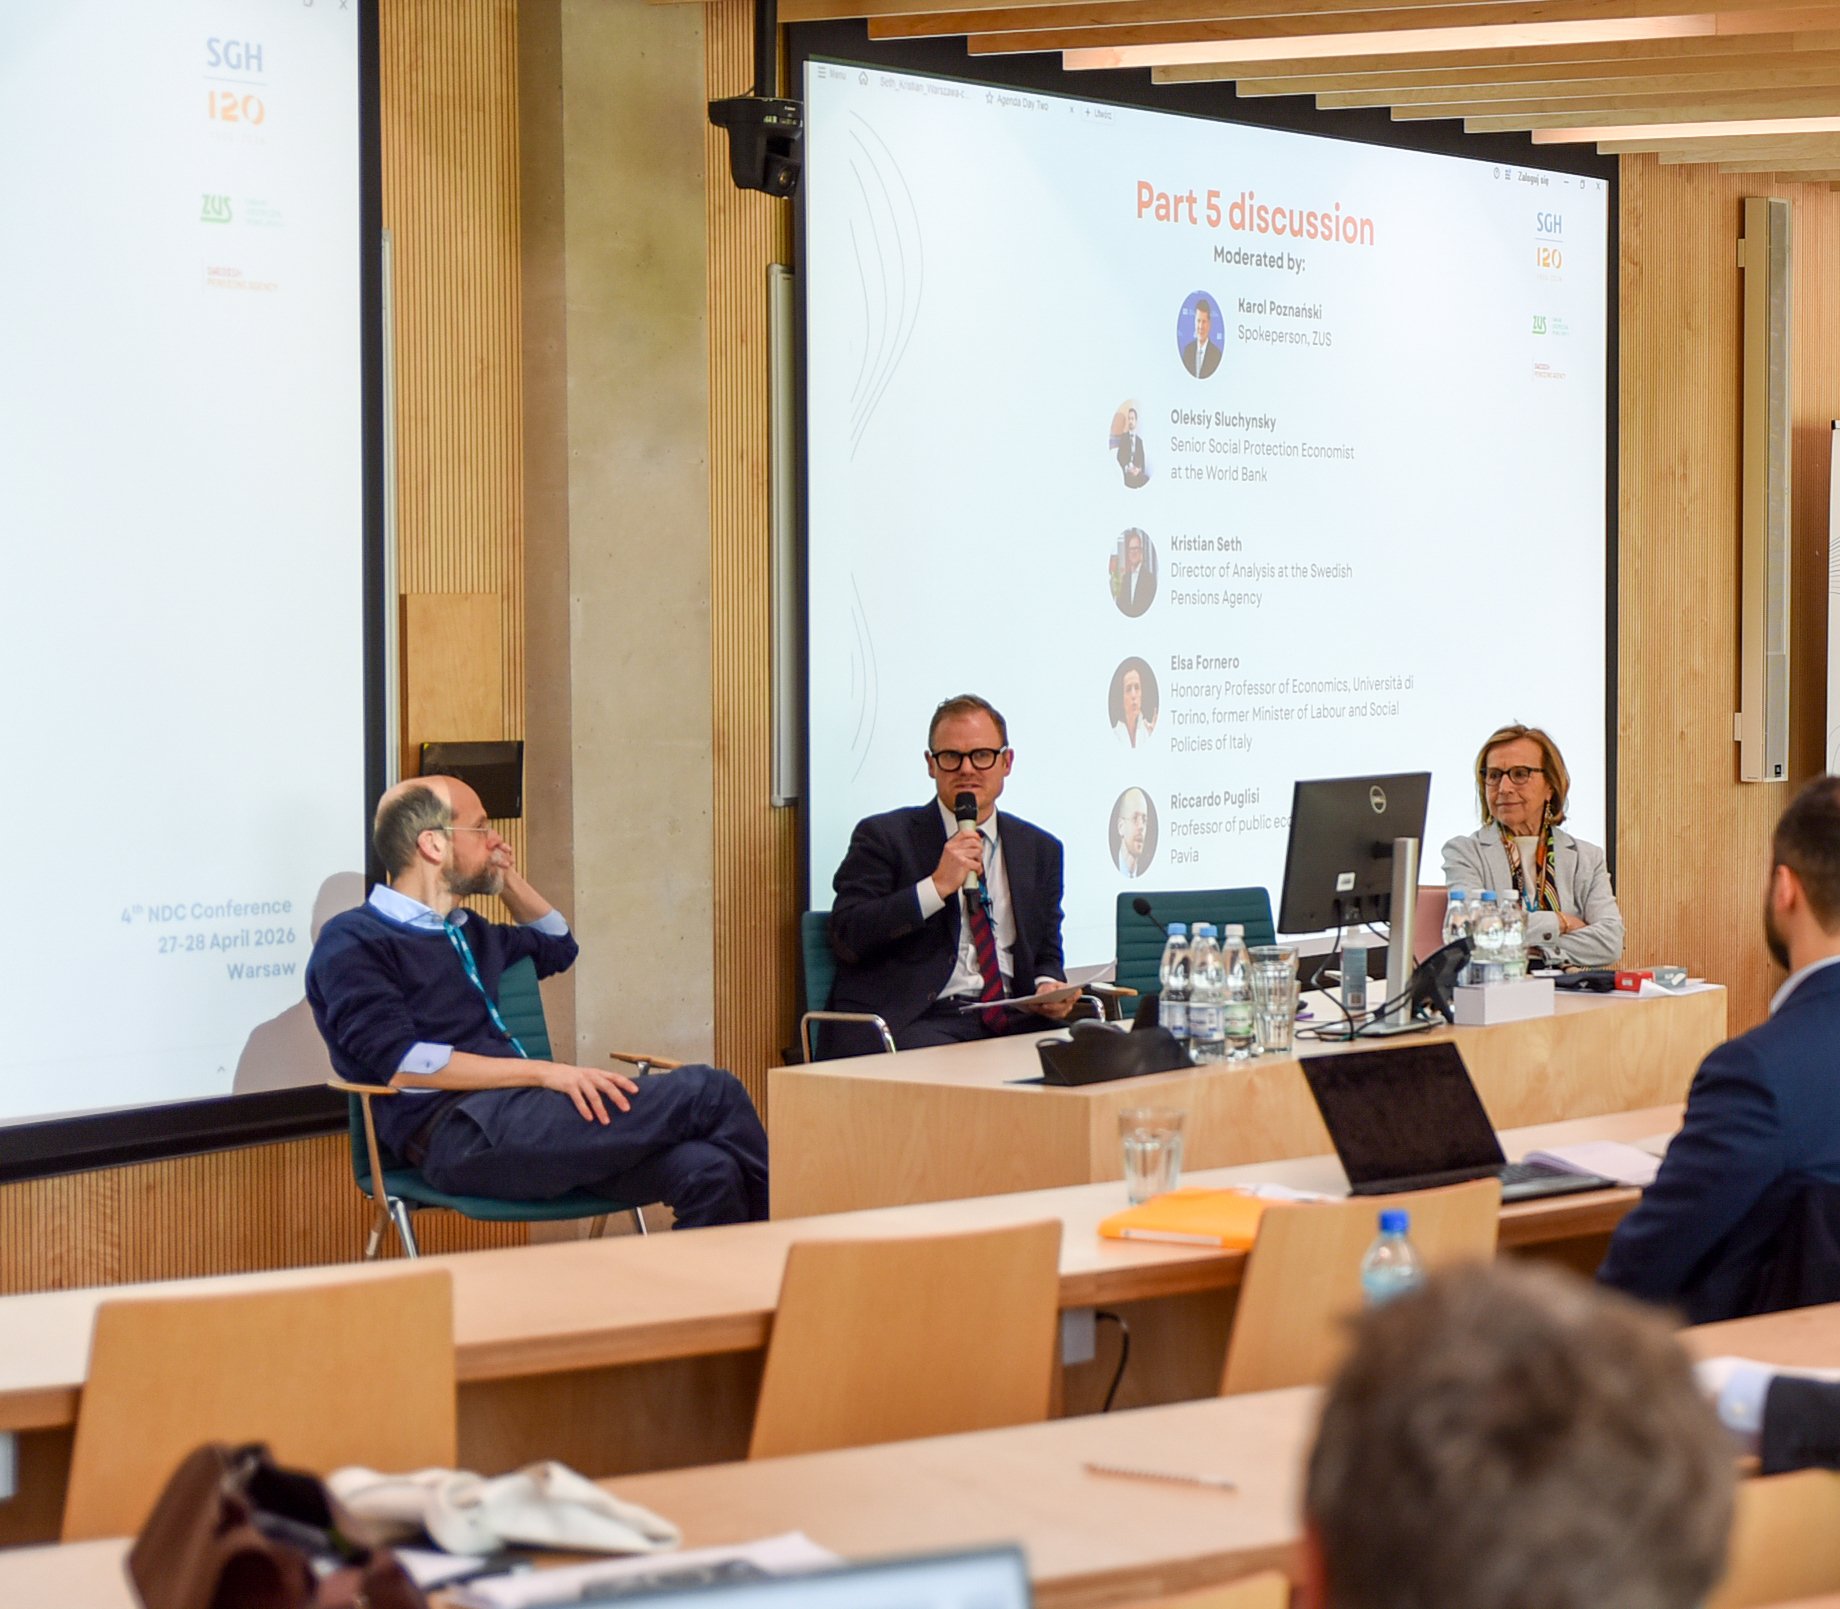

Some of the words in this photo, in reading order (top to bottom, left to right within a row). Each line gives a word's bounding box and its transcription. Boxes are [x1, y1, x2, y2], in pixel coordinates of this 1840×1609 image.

[206, 37, 263, 72] SGH
[208, 90, 265, 126] 120
[997, 93, 1021, 108] Agenda
[1022, 97, 1035, 111] Day
[1036, 98, 1048, 111] Two
[200, 194, 232, 223] ZUS
[1137, 180, 1197, 225] Part
[1206, 189, 1222, 229] 5
[1229, 191, 1374, 246] discussion
[1537, 212, 1562, 234] SGH
[1214, 245, 1284, 270] Moderated
[1287, 253, 1306, 275] by:
[1537, 247, 1562, 269] 120
[1238, 298, 1267, 315] Karol
[1269, 301, 1322, 320] Poznański
[1532, 315, 1546, 334] ZUS
[1238, 324, 1310, 347] Spokeperson,
[1312, 331, 1332, 348] ZUS
[1171, 409, 1212, 429] Oleksiy
[1214, 411, 1276, 432] Sluchynsky
[1171, 436, 1205, 452] Senior
[1209, 438, 1241, 454] Social
[1244, 440, 1299, 457] Protection
[1301, 443, 1354, 460] Economist
[1171, 466, 1182, 480] at
[1185, 464, 1203, 480] the
[1206, 465, 1239, 481] World
[1242, 466, 1267, 482] Bank
[1171, 535, 1214, 552] Kristian
[1217, 536, 1242, 552] Seth
[1171, 562, 1216, 578] Director
[1219, 562, 1230, 578] of
[1232, 562, 1275, 581] Analysis
[1278, 564, 1289, 578] at
[1291, 563, 1308, 578] the
[1310, 563, 1353, 579] Swedish
[1171, 589, 1220, 605] Pensions
[1222, 590, 1262, 608] Agency
[1171, 655, 1193, 670] Elsa
[1196, 655, 1240, 670] Fornero
[1171, 683, 1222, 700] Honorary
[1225, 679, 1276, 696] Professor
[1278, 678, 1290, 694] of
[1292, 677, 1351, 694] Economics,
[1404, 674, 1414, 689] di
[1171, 708, 1209, 726] Torino,
[1212, 707, 1249, 724] former
[1252, 704, 1294, 722] Minister
[1297, 703, 1309, 720] of
[1311, 702, 1346, 719] Labour
[1349, 702, 1367, 718] and
[1370, 700, 1400, 717] Social
[1171, 736, 1213, 752] Policies
[1215, 734, 1228, 750] of
[1229, 733, 1252, 752] Italy
[1171, 790, 1221, 809] Riccardo
[1223, 787, 1260, 808] Puglisi
[1171, 819, 1223, 837] Professor
[1225, 816, 1236, 833] of
[1239, 813, 1272, 835] public
[1171, 847, 1199, 864] Pavia
[121, 904, 144, 925] 4th
[148, 904, 187, 923] NDC
[190, 899, 292, 920] Conference
[158, 933, 206, 954] 27-28
[209, 929, 251, 952] April
[254, 928, 296, 947] 2026
[227, 961, 296, 980] Warsaw
